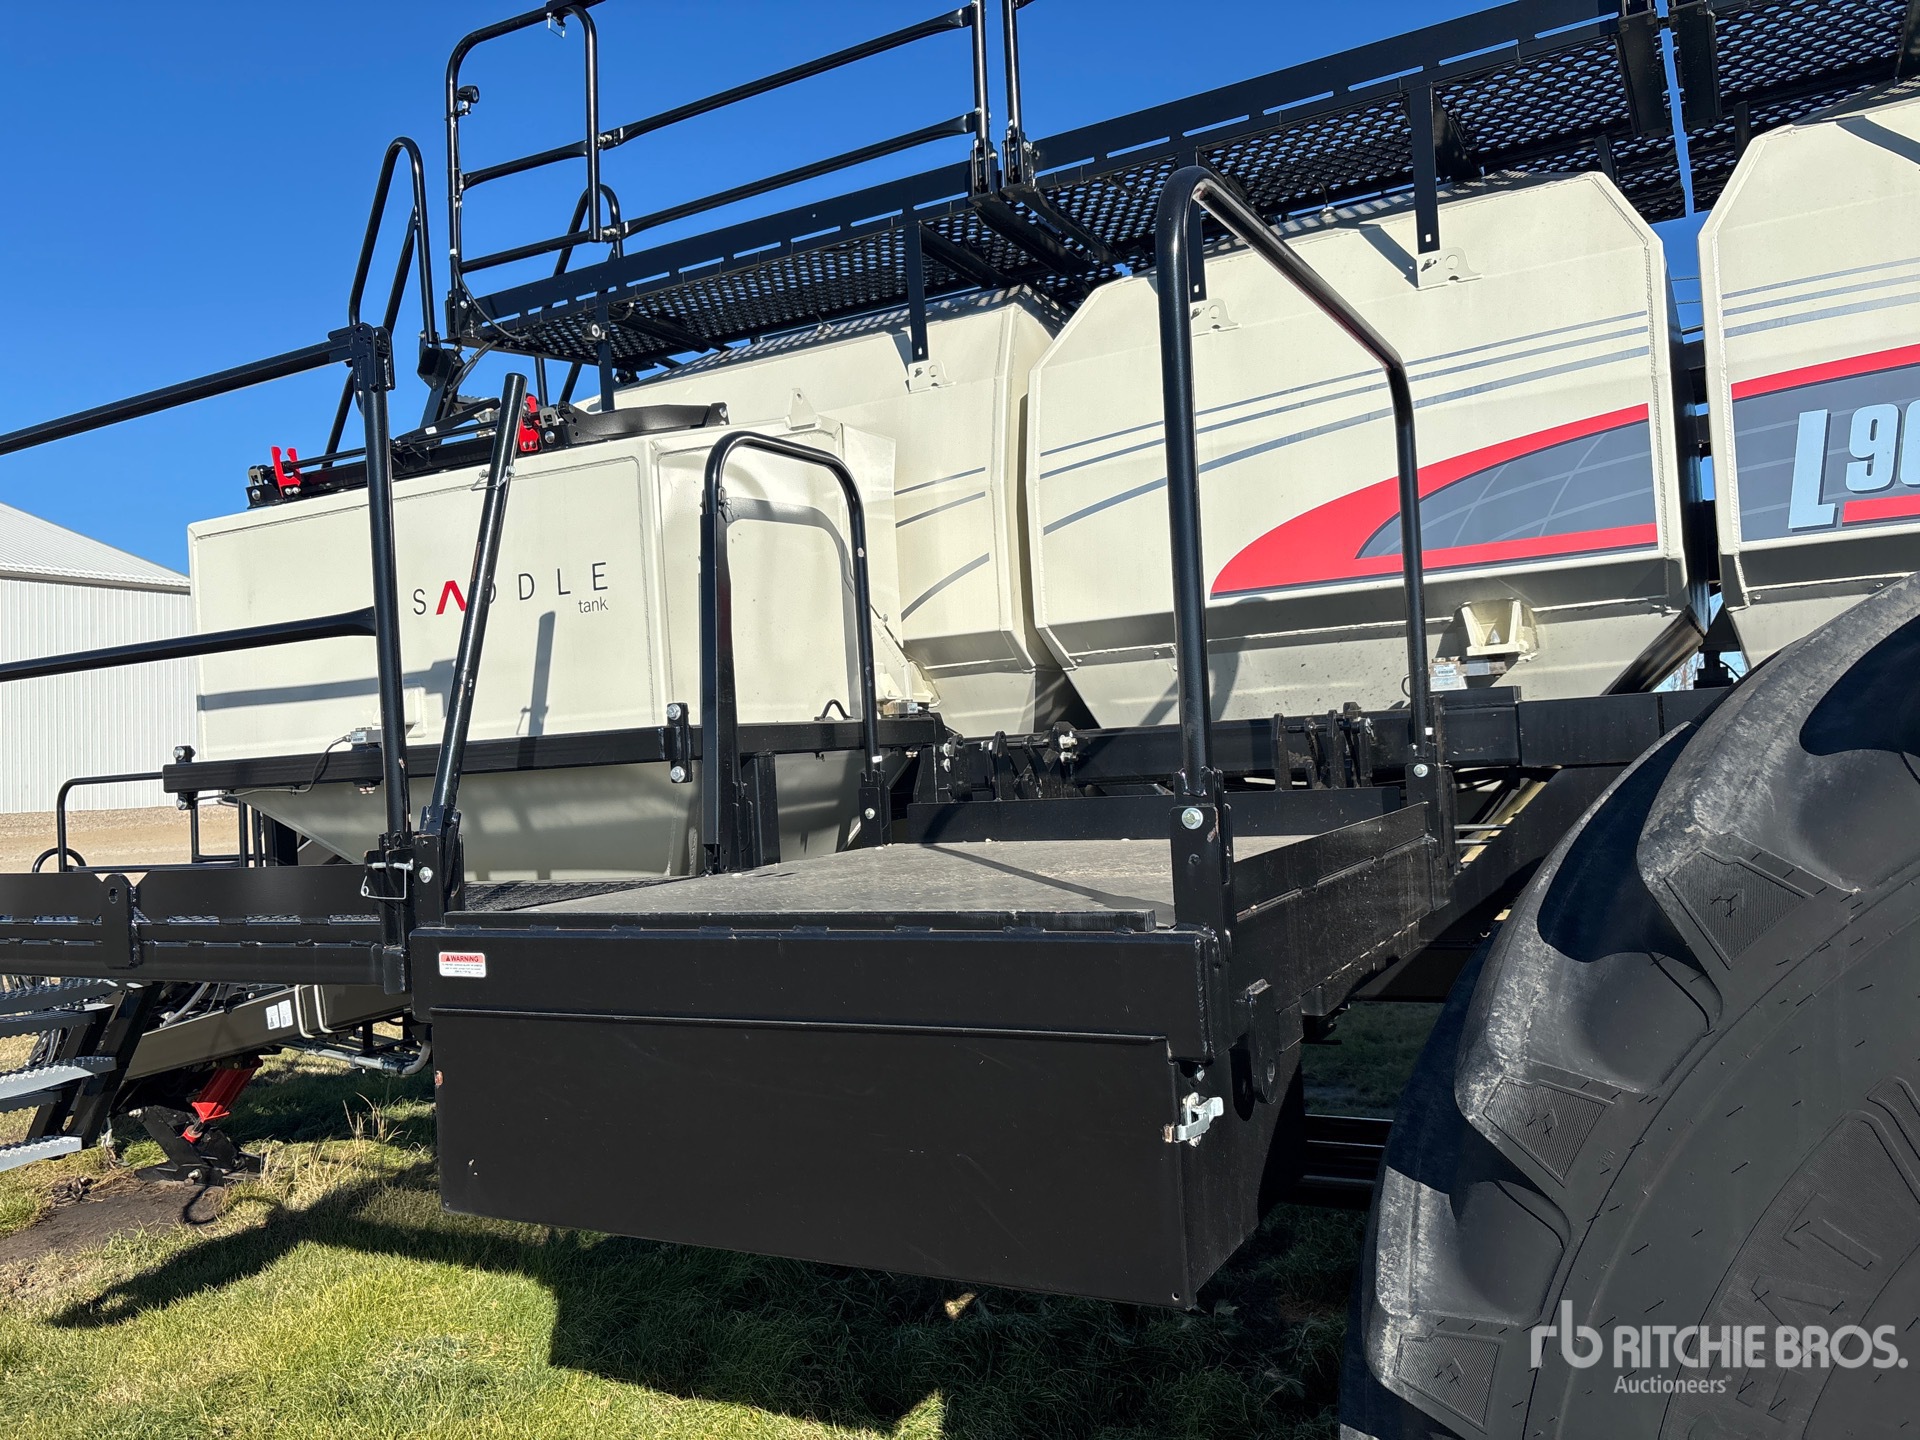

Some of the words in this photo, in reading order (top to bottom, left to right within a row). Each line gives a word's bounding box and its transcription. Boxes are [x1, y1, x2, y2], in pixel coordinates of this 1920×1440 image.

[412, 561, 608, 616] SADLE
[577, 596, 609, 614] tank
[450, 955, 479, 963] WARNING
